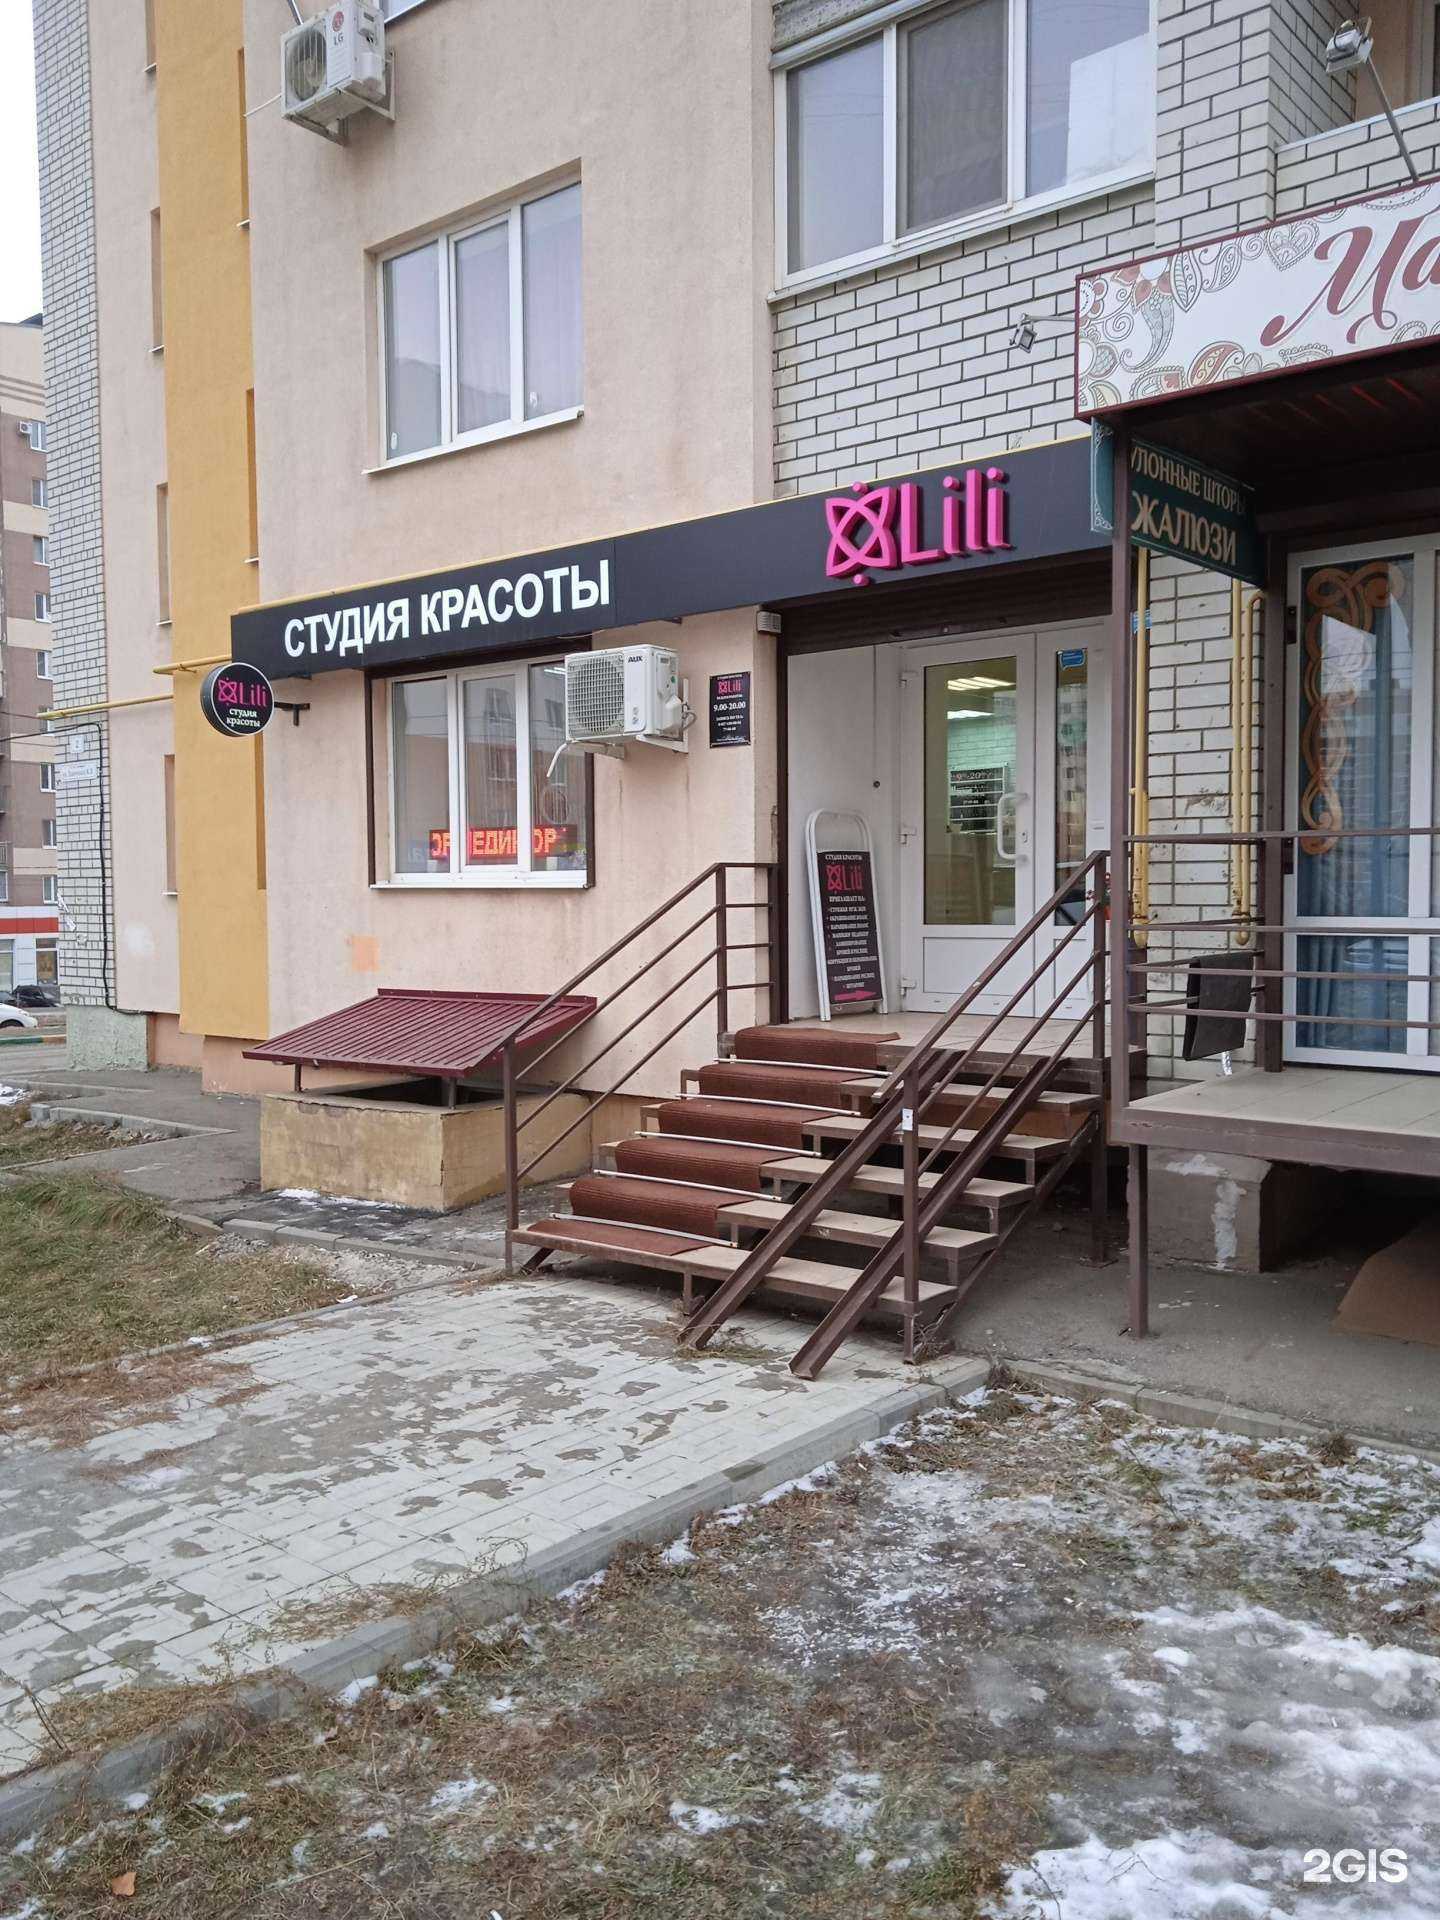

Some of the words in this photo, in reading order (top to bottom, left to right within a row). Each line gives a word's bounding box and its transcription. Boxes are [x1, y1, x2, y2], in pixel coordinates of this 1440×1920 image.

[901, 467, 1008, 565] Lili
[1130, 490, 1236, 566] ЖАЛЮЗИ
[284, 598, 410, 657] СТУДИЯ
[420, 559, 609, 635] КРАСОТЫ
[226, 717, 260, 727] красоты
[229, 708, 258, 718] студия
